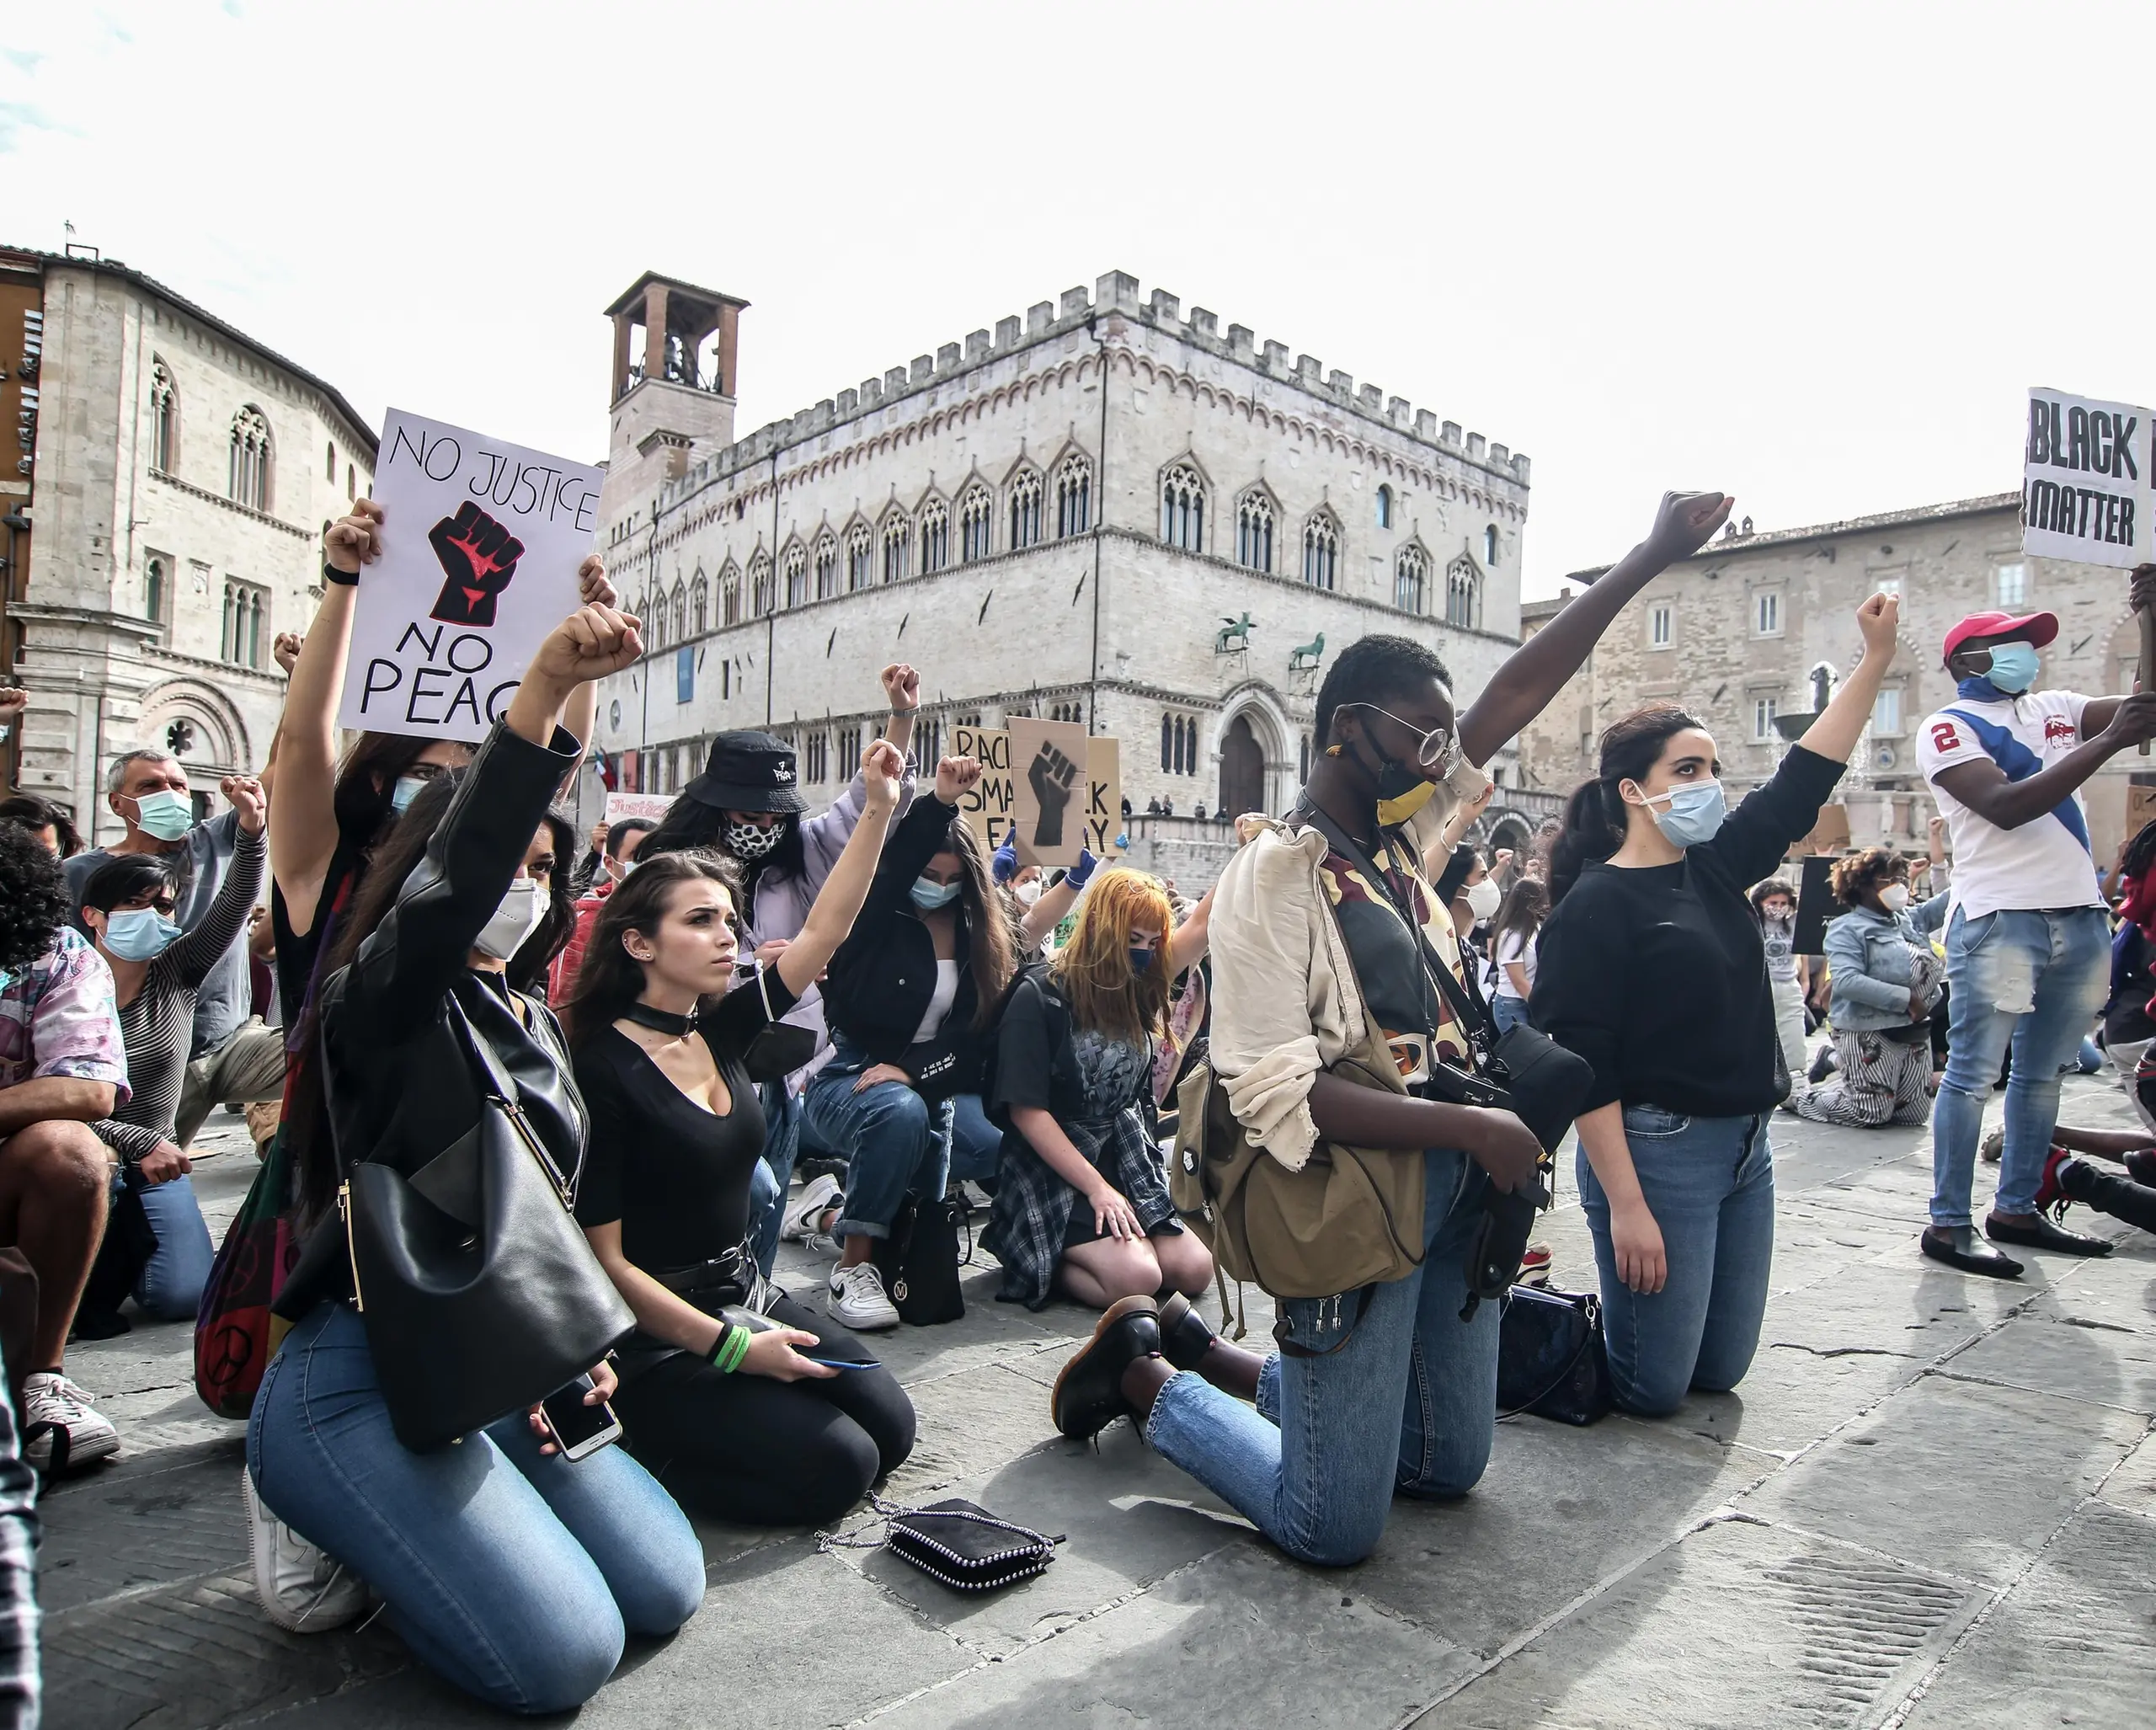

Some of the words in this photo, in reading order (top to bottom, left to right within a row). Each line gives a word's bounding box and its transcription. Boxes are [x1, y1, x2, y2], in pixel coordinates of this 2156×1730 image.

[2029, 398, 2137, 480] BLACK
[389, 426, 461, 481] NO
[469, 451, 600, 532] JUSTICE
[2030, 479, 2135, 547] MATTER
[395, 622, 493, 673] NO
[360, 658, 521, 724] PEAC
[957, 730, 1010, 769] RACI
[1931, 723, 1961, 753] 2
[963, 777, 1014, 813] SMA
